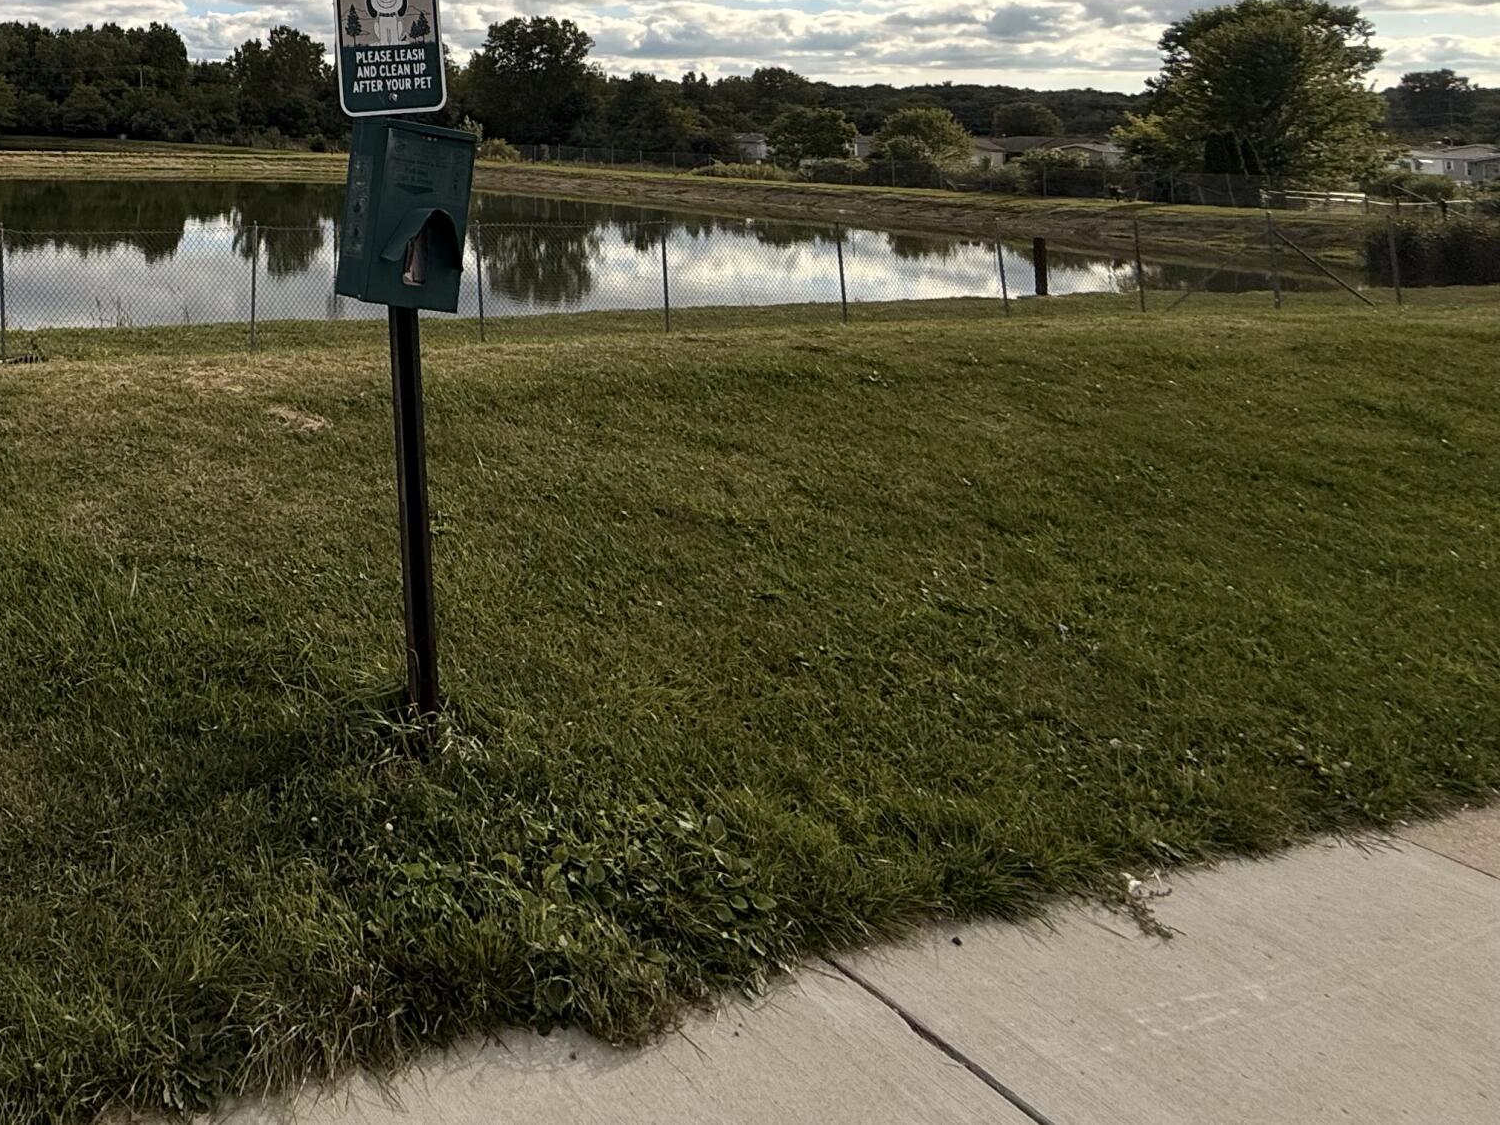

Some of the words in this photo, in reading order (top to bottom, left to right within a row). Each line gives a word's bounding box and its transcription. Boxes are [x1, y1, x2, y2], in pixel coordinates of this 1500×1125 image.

[356, 49, 392, 64] PLEASE
[395, 48, 425, 62] LEASH
[357, 64, 377, 79] AND
[380, 63, 411, 77] CLEAN
[414, 62, 426, 75] UP
[353, 80, 383, 93] AFTER
[386, 78, 412, 91] YOUR
[414, 76, 432, 89] PET
